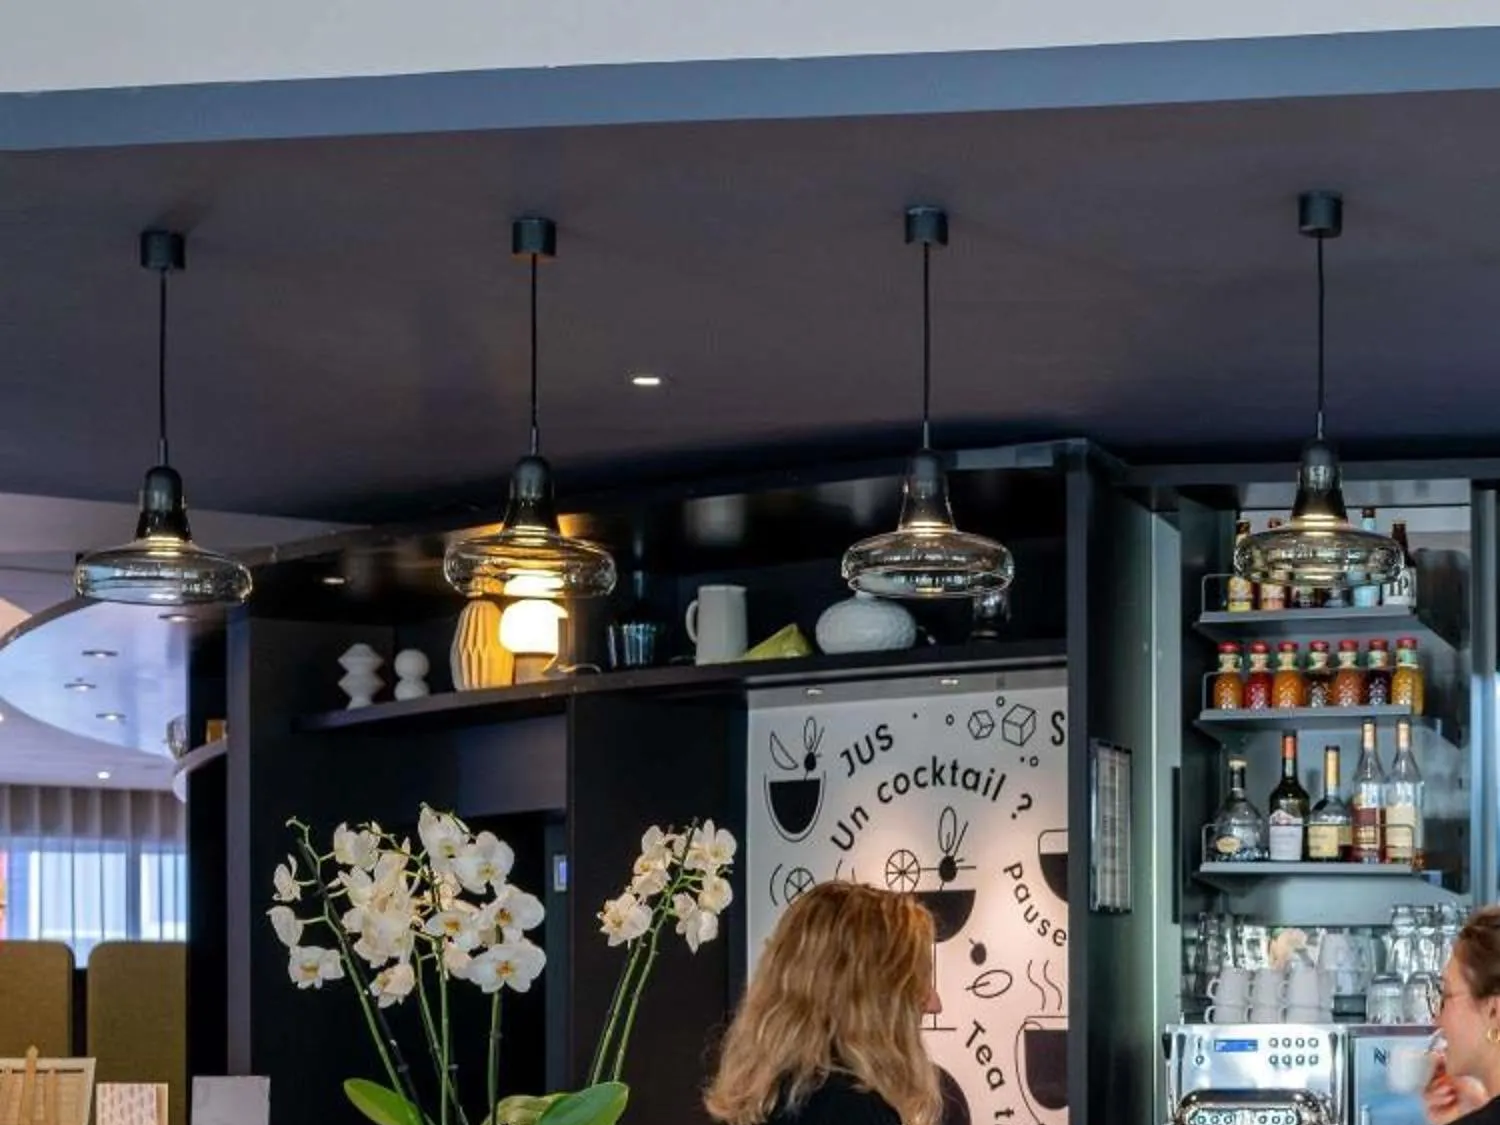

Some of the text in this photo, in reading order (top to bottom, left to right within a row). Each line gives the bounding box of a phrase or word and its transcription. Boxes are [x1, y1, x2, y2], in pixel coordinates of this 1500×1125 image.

[839, 723, 894, 778] JUS
[830, 755, 1033, 852] Un cocktail ?
[965, 1018, 1006, 1092] Tea
